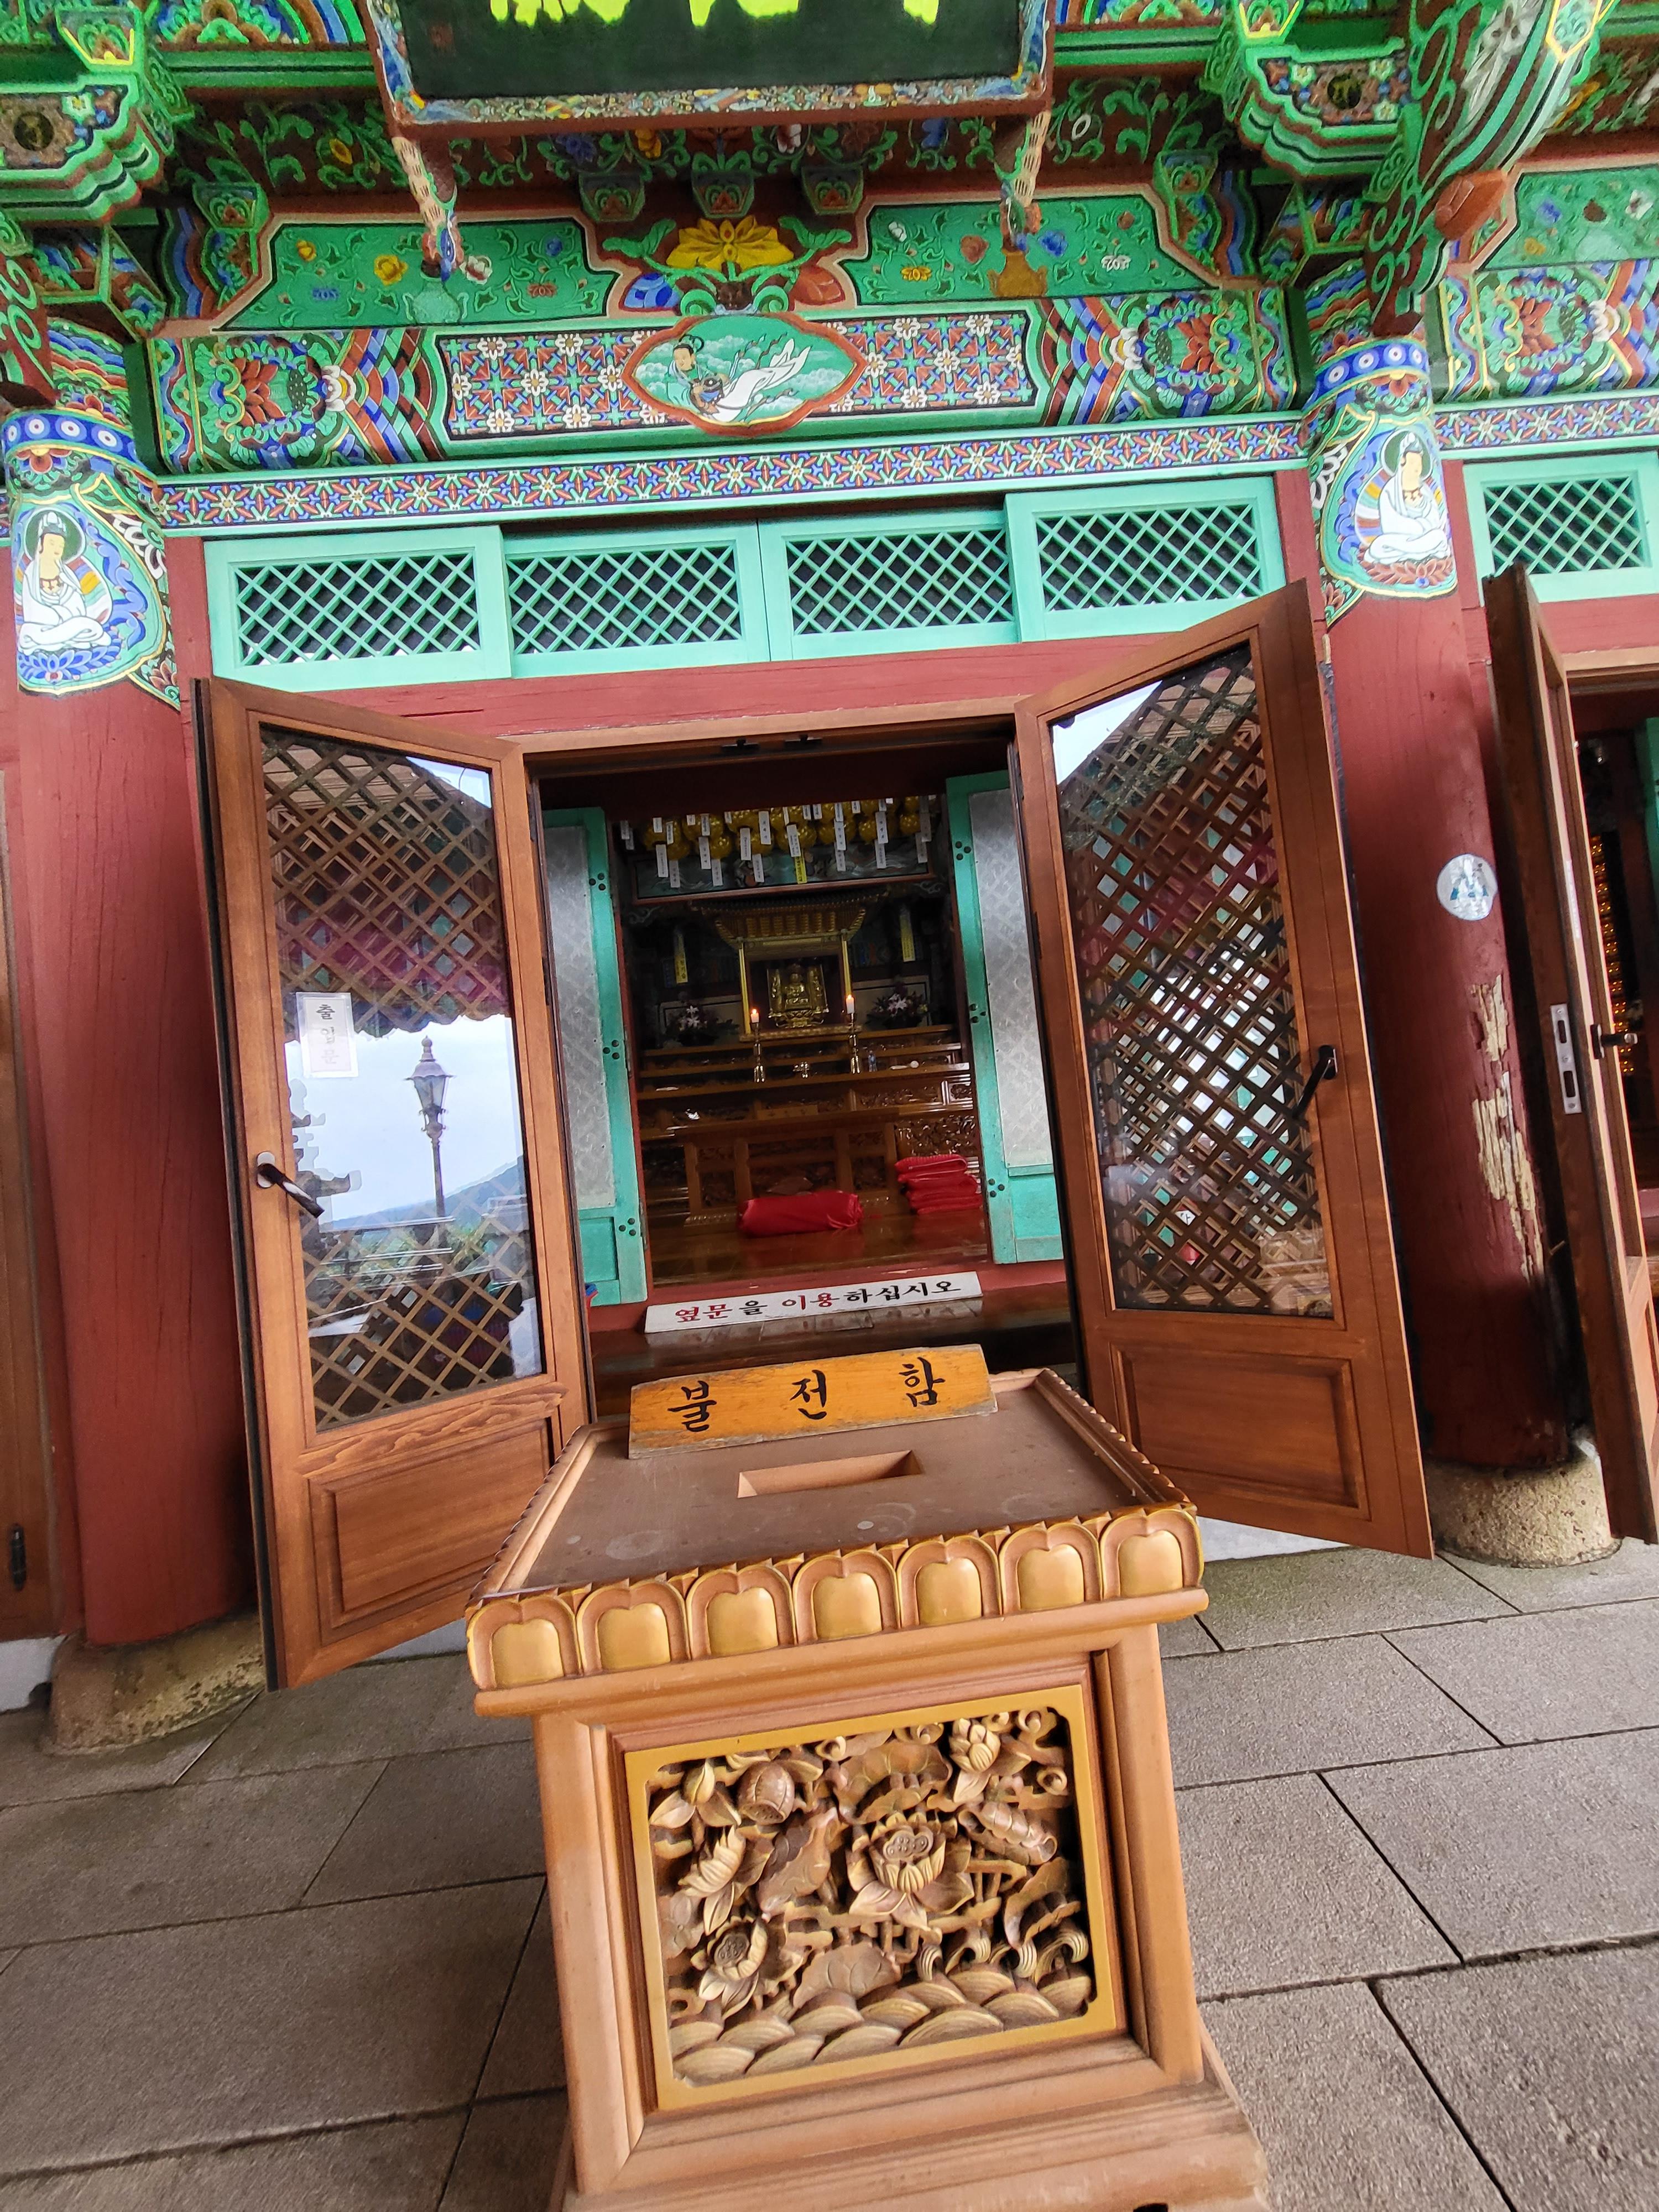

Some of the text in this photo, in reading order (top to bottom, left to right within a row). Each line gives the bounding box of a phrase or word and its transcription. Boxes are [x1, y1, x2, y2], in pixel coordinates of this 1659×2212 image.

[316, 1004, 340, 1064] 출입문
[675, 1281, 962, 1323] 옆문을 이용하십시오
[667, 1357, 946, 1432] 불전함
